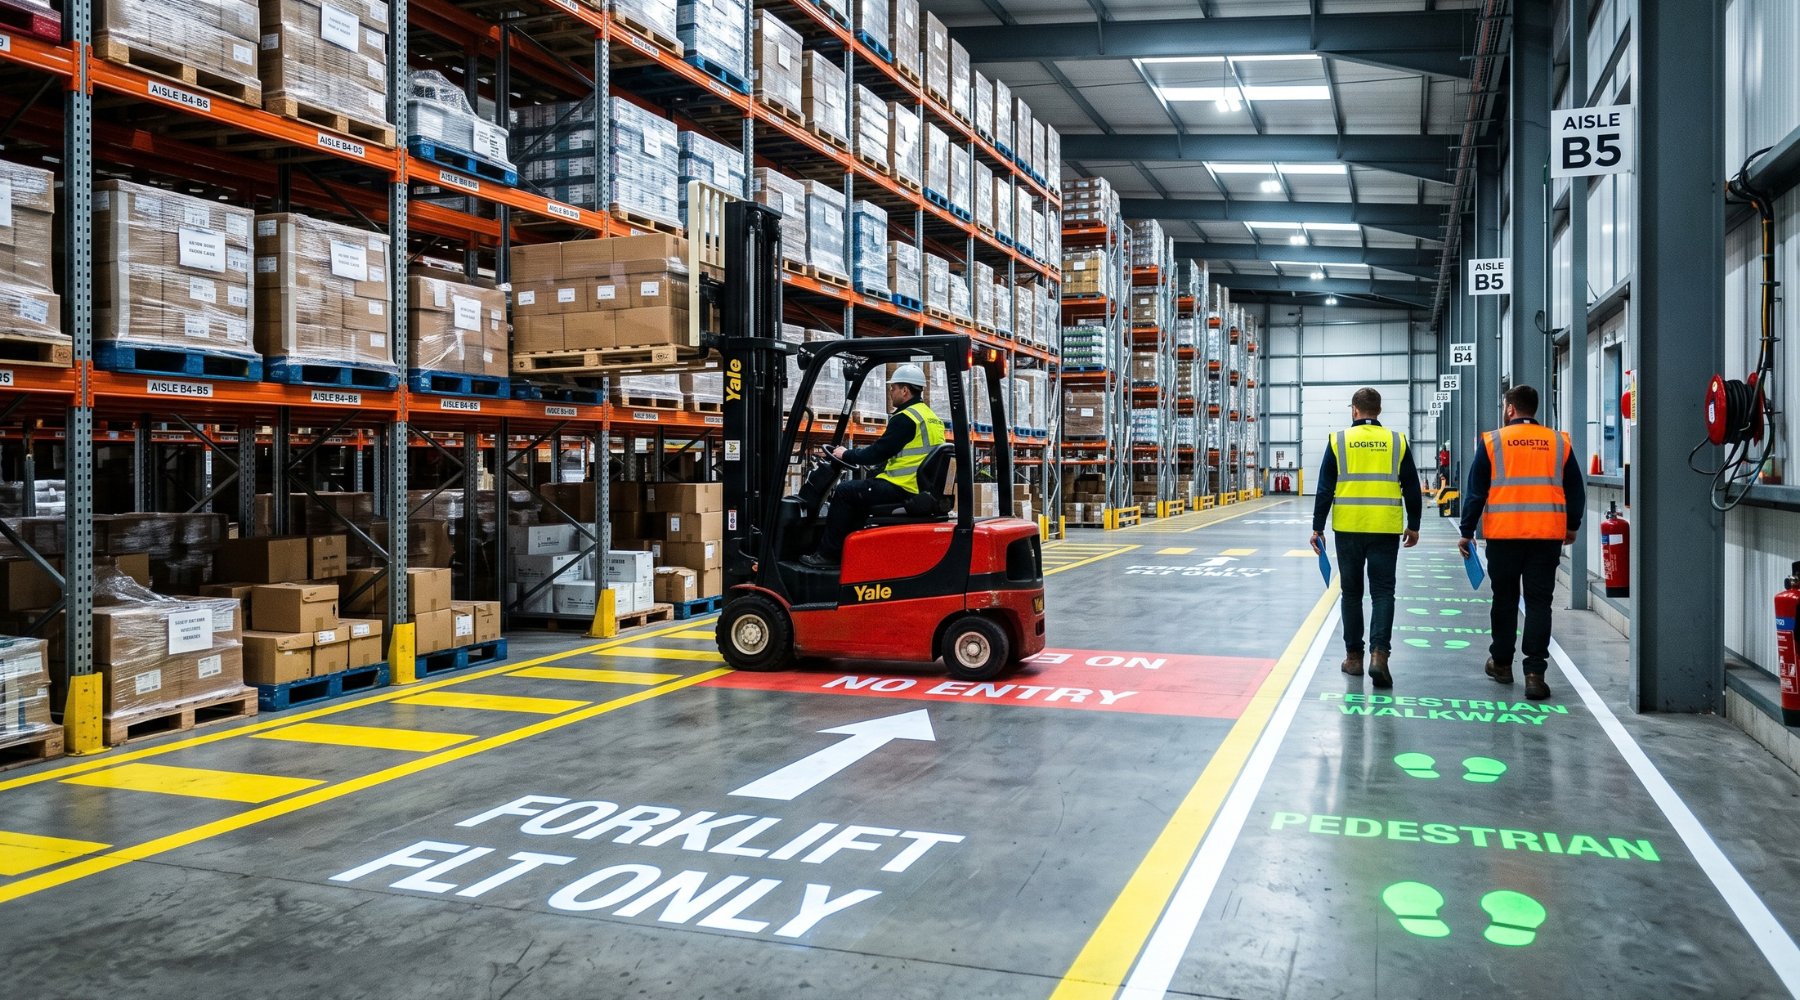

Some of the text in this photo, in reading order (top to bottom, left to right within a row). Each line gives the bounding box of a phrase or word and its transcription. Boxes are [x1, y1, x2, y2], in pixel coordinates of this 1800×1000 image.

[152, 84, 208, 109] AISLE B4-B6
[1562, 112, 1620, 131] AISLE
[319, 136, 341, 149] AISLE
[1561, 133, 1622, 169] B5
[1475, 261, 1504, 271] AISLE
[1475, 273, 1504, 291] B5
[1454, 352, 1472, 363] B4
[151, 382, 209, 395] AISLE B4-B5
[726, 358, 741, 402] Yale
[1443, 380, 1457, 389] B5
[313, 393, 334, 402] AISLE
[442, 400, 459, 409] AISLE
[1349, 441, 1387, 449] LOGISTIX
[1507, 439, 1549, 447] LOGISTIX
[854, 583, 892, 602] Yale
[821, 675, 1140, 706] NO ENTRY
[1319, 692, 1569, 715] PEDESTRIAN
[1337, 704, 1549, 726] WALKWAY
[455, 794, 965, 874] FORKLIFT
[1269, 811, 1661, 863] PEDESTRIAN
[329, 840, 882, 938] FLT ONLY
